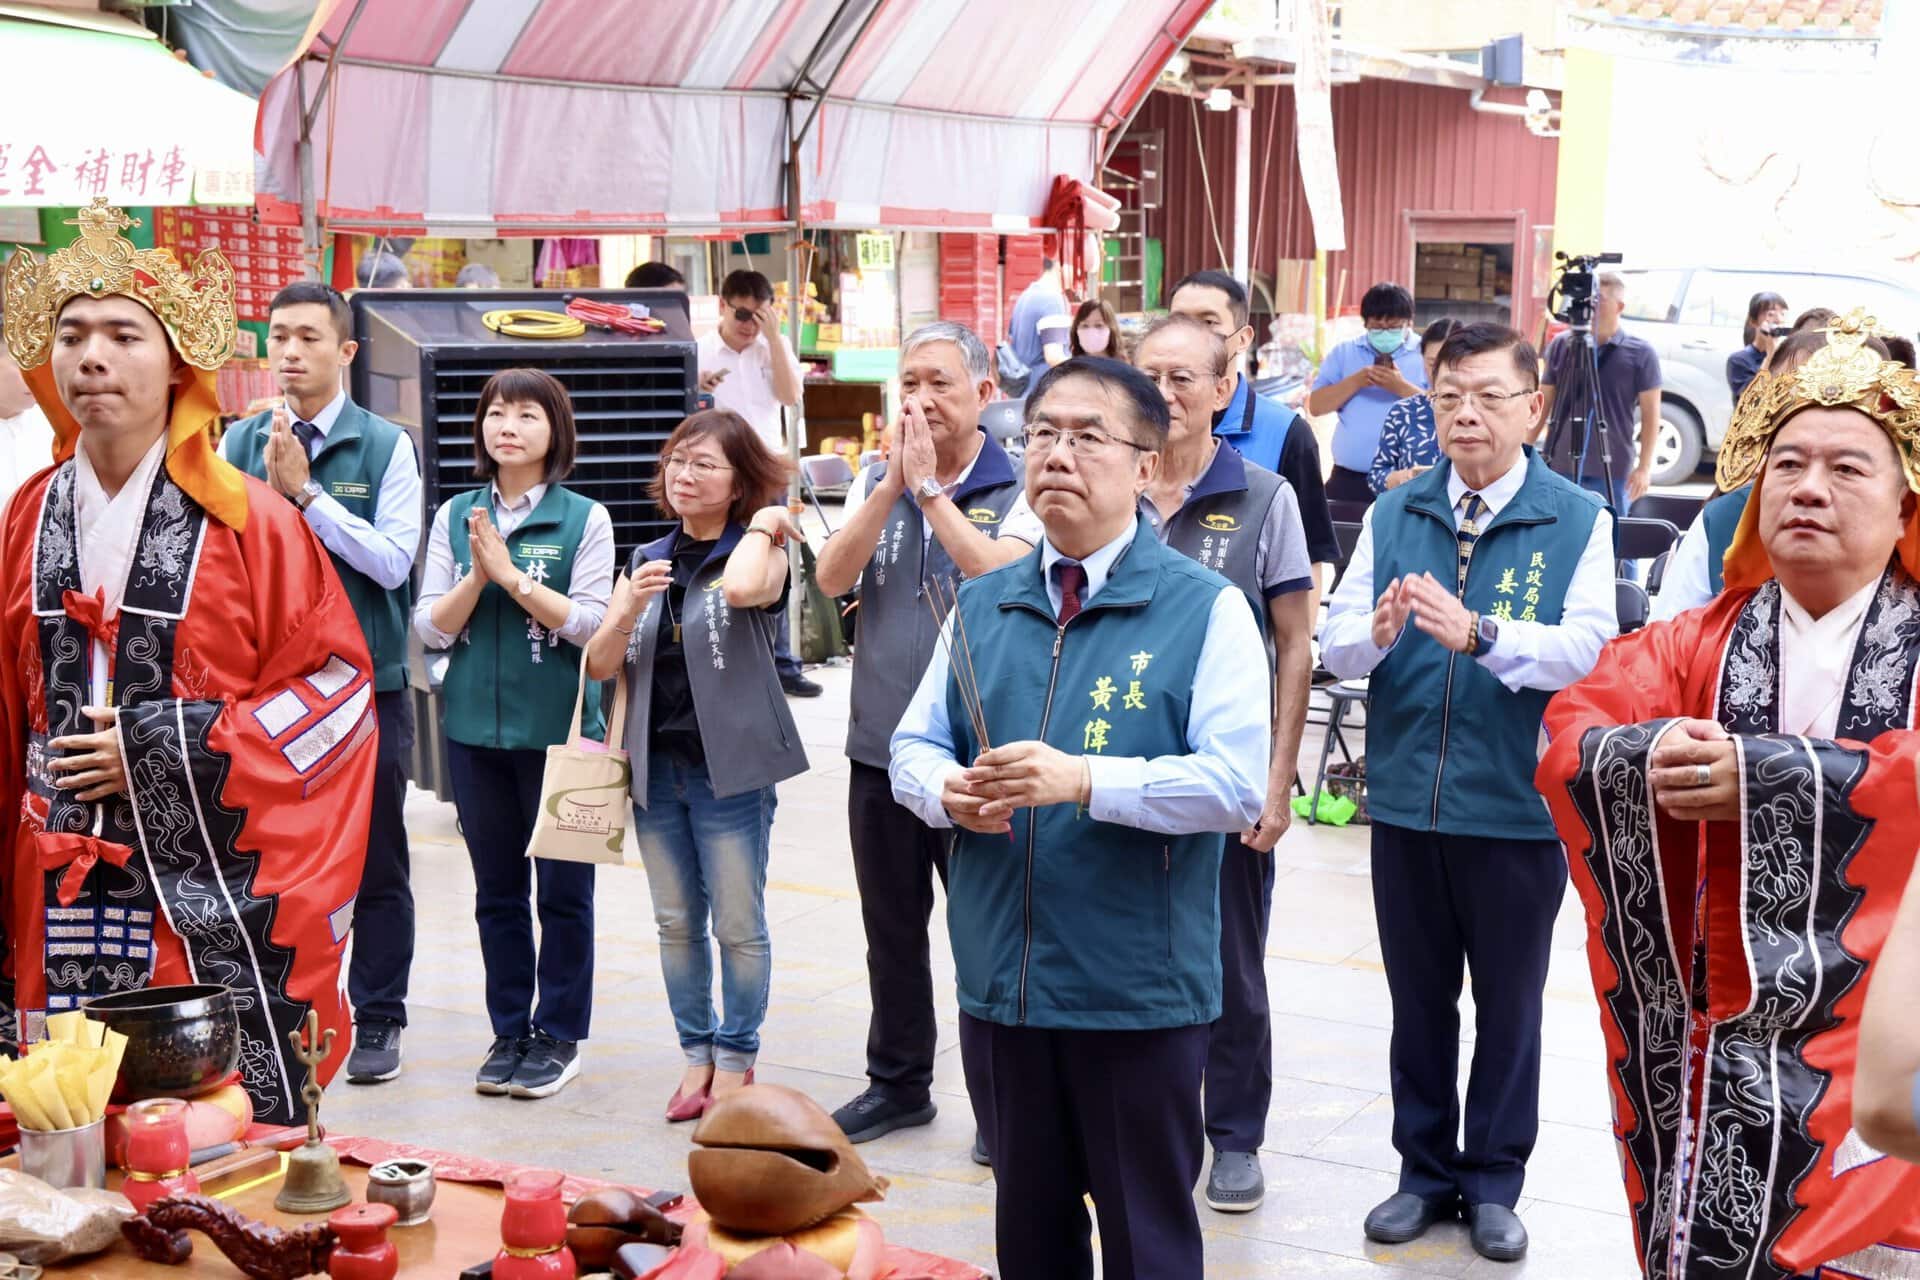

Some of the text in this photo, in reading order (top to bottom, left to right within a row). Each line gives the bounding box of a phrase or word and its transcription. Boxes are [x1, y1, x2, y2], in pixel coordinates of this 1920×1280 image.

[1198, 535, 1213, 569] 台灣
[1215, 537, 1230, 576] 財團法
[1520, 552, 1546, 622] 民政局局
[1122, 650, 1153, 710] 市長
[1084, 676, 1118, 754] 黃偉
